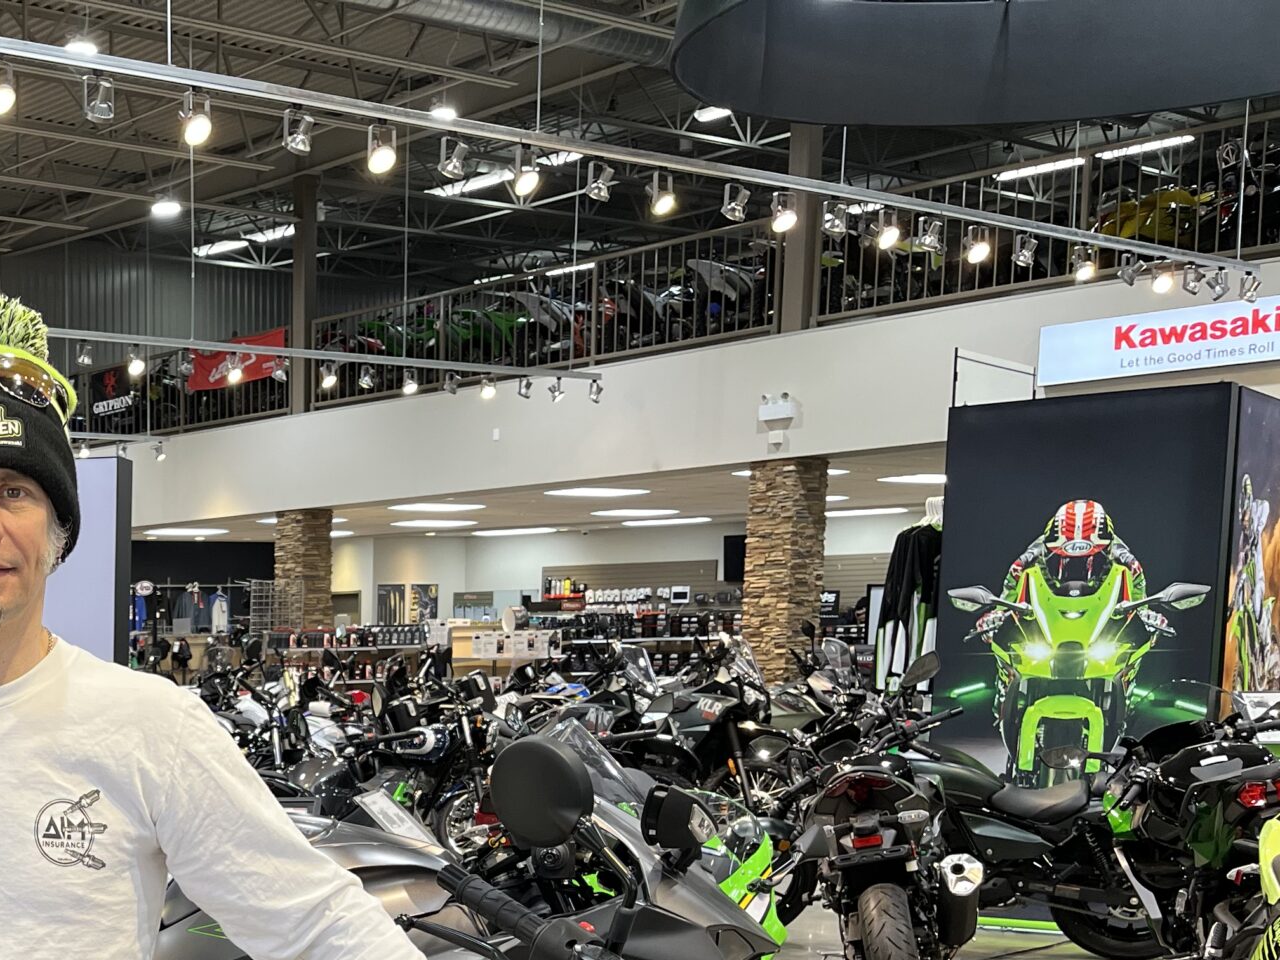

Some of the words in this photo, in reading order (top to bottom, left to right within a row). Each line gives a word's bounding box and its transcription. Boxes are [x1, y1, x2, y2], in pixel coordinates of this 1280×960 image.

[1114, 305, 1280, 350] Kawasaki
[1120, 357, 1140, 369] Let
[1144, 353, 1164, 367] the
[1167, 349, 1202, 364] Good
[1205, 345, 1245, 360] Times
[1248, 341, 1275, 355] Roll
[93, 394, 133, 414] GRYPHON
[696, 696, 723, 716] KLR
[42, 841, 86, 849] INSURANCE
